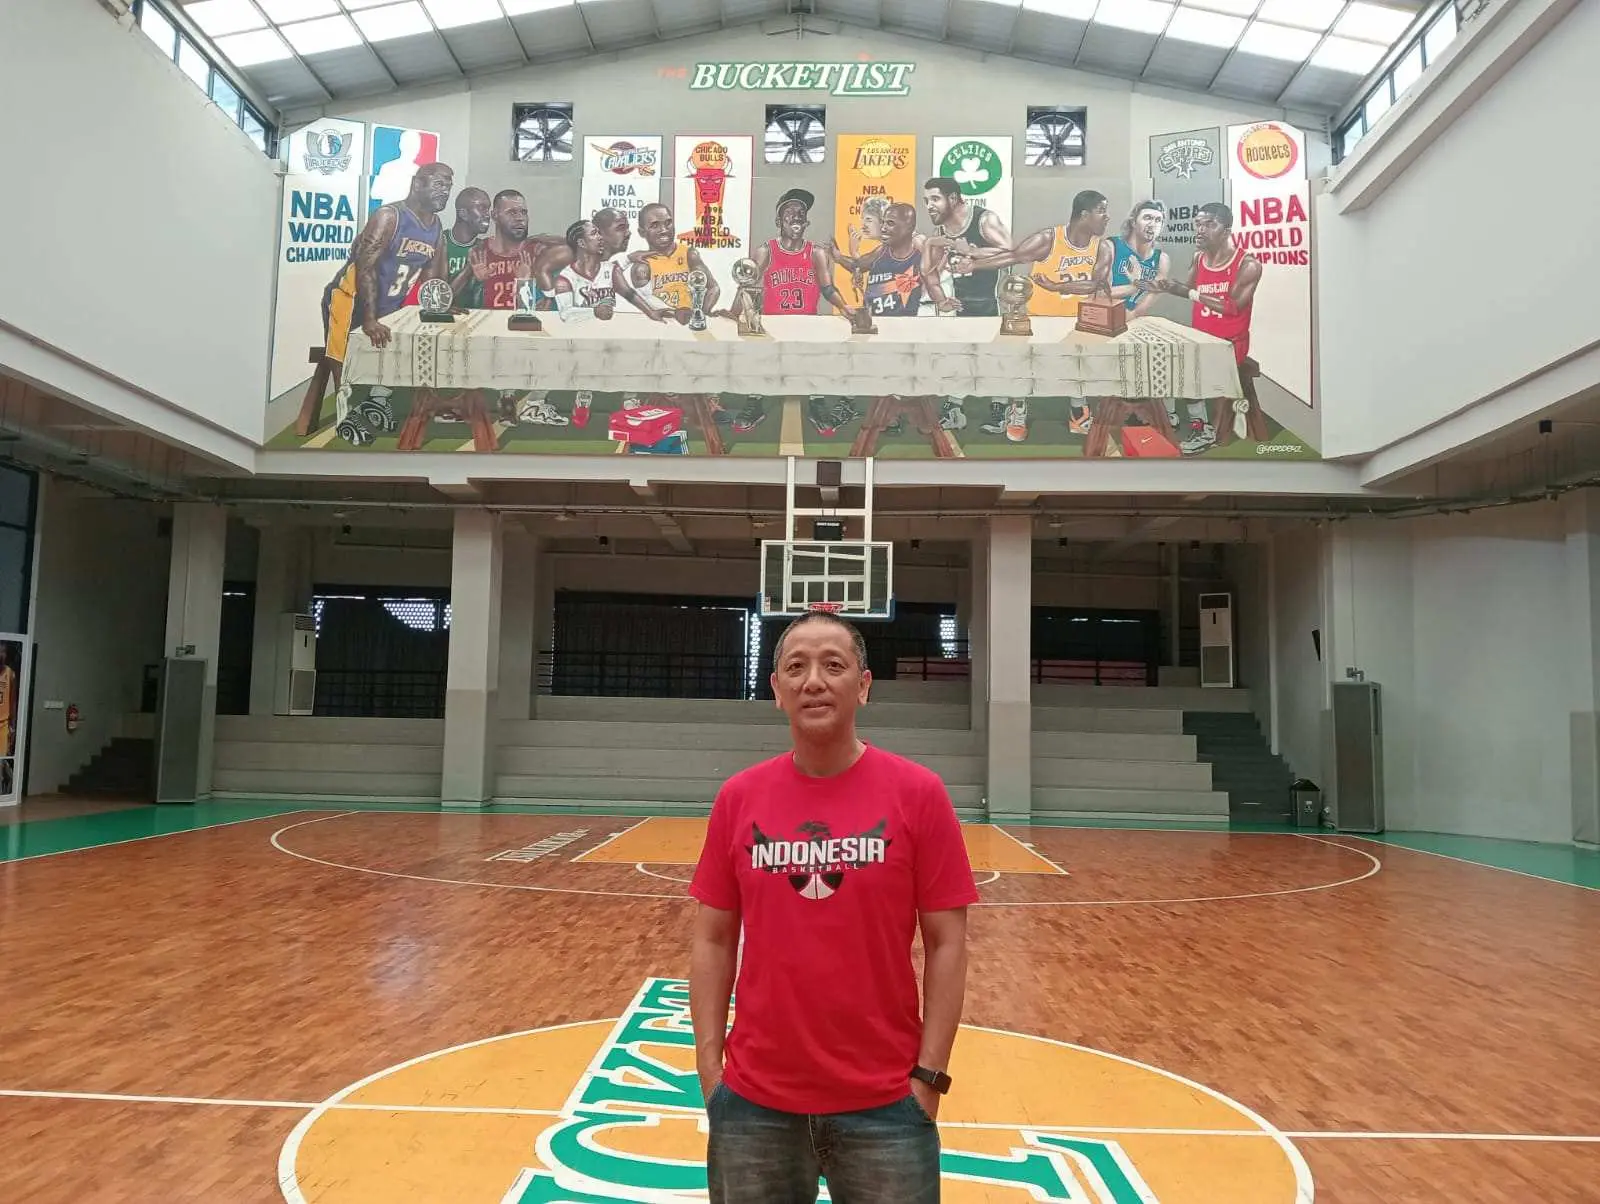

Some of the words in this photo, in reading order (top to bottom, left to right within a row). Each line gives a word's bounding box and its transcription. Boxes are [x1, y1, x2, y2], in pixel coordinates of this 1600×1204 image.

[851, 147, 909, 170] LAKERS
[947, 144, 993, 165] CELTICS
[608, 184, 637, 196] NBA
[863, 185, 886, 195] NBA
[291, 190, 354, 221] NBA
[601, 198, 644, 209] WORLD
[1240, 194, 1307, 227] NBA
[701, 215, 723, 225] NBA
[1167, 222, 1195, 232] WORL
[288, 221, 354, 244] WORLD
[694, 227, 730, 237] WORLD
[1230, 227, 1303, 250] WORLD
[770, 269, 818, 288] BULLS
[779, 288, 805, 309] 23
[872, 294, 897, 314] 34
[752, 837, 886, 869] INDONESIA
[772, 863, 860, 874] BASKETBALL
